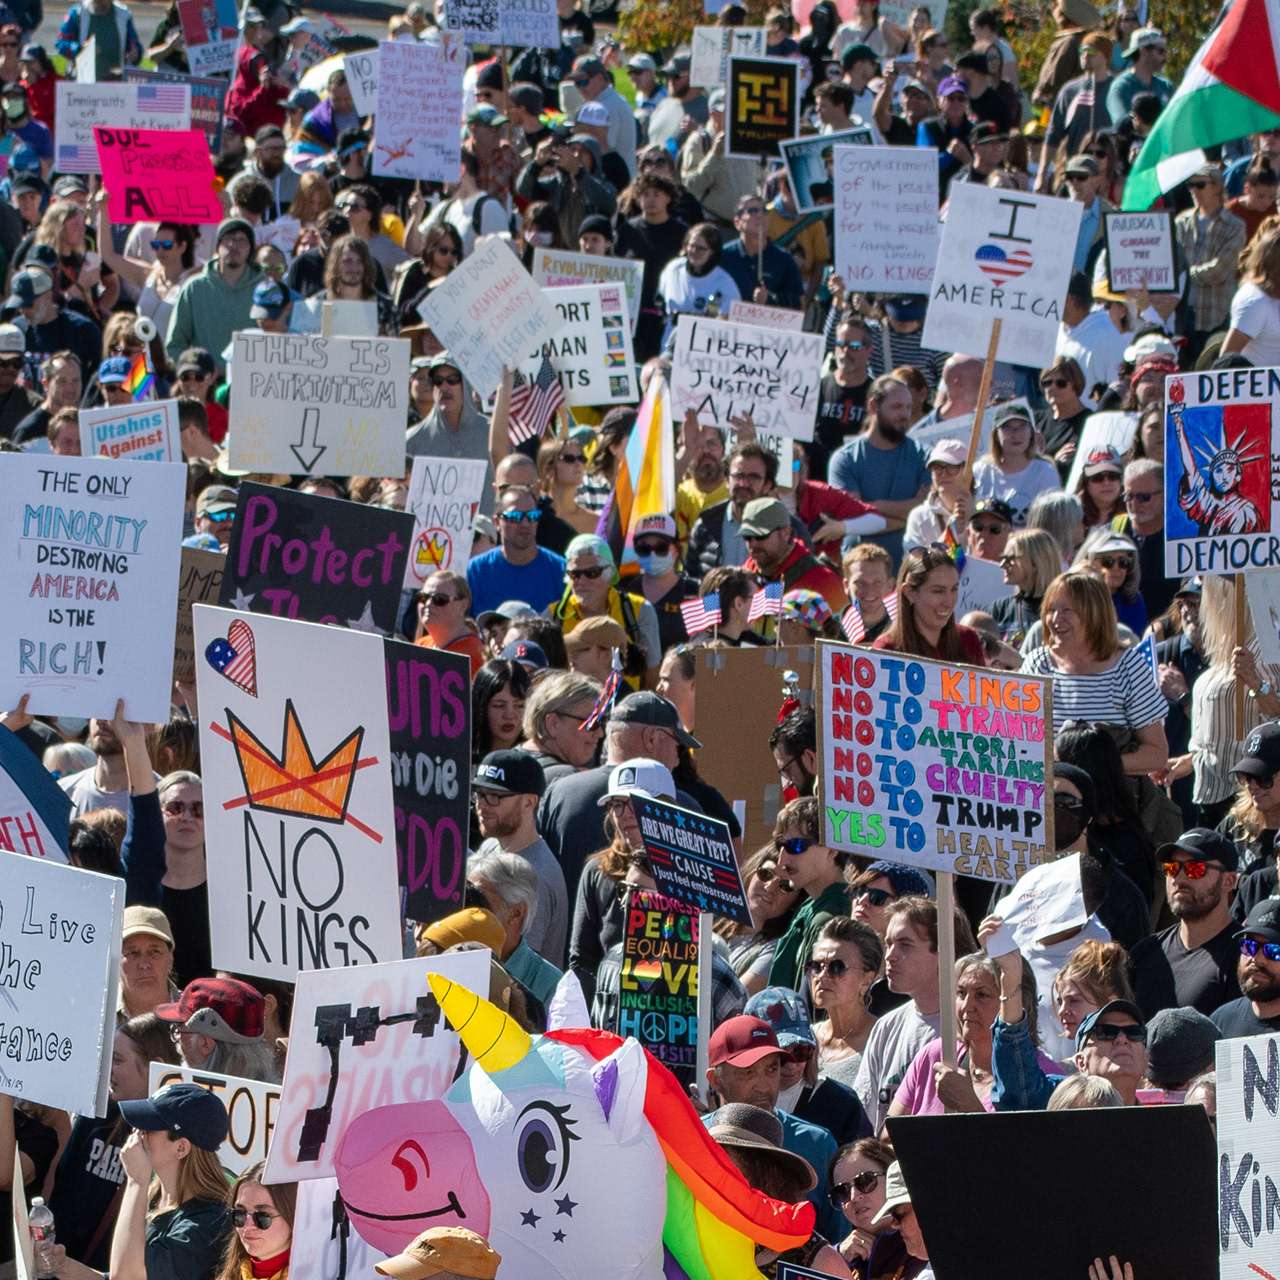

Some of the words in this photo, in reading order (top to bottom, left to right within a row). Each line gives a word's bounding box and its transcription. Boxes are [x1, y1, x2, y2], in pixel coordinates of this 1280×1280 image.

[840, 152, 938, 175] Government
[124, 186, 211, 220] ALL
[847, 264, 874, 281] NO
[884, 264, 936, 281] KINGS
[934, 281, 1062, 322] AMERICA
[238, 334, 329, 367] THIS
[349, 340, 391, 376] IS
[690, 321, 788, 367] LIBERTY
[250, 370, 397, 409] PATRIOTISM
[690, 369, 780, 399] JUSTICE
[791, 385, 809, 410] 4
[733, 363, 780, 382] AND
[96, 412, 161, 443] Utahns
[99, 430, 163, 458] Against
[37, 469, 80, 495] THE
[86, 474, 132, 497] ONLY
[421, 463, 458, 496] NO
[23, 505, 148, 553] MINORITY
[238, 494, 400, 587] Protect
[37, 543, 129, 574] DESTROYNG
[29, 572, 120, 601] AMERICA
[48, 609, 63, 627] IS
[65, 608, 95, 627] THE
[20, 640, 107, 678] RICH!
[830, 652, 876, 689] NO
[880, 658, 926, 696] TO
[832, 688, 874, 716] NO
[878, 691, 922, 725] TO
[930, 699, 1045, 743] TYRANTS
[417, 754, 458, 801] Die
[833, 747, 873, 777] NO
[875, 754, 916, 787] TO
[925, 763, 1045, 809] CRUELTY
[833, 775, 875, 807] NO
[880, 788, 924, 816] TO
[931, 794, 1043, 838] TRUMP
[641, 816, 659, 841] ARE
[658, 821, 675, 847] WE
[674, 828, 705, 856] GREAT
[705, 838, 731, 863] YET?
[826, 806, 886, 848] YES
[889, 816, 926, 852] TO
[937, 828, 1046, 865] HEALTH
[244, 810, 345, 912] NO
[670, 853, 716, 883] 'CAUSE
[21, 885, 96, 945] Live
[246, 897, 380, 972] KINGS
